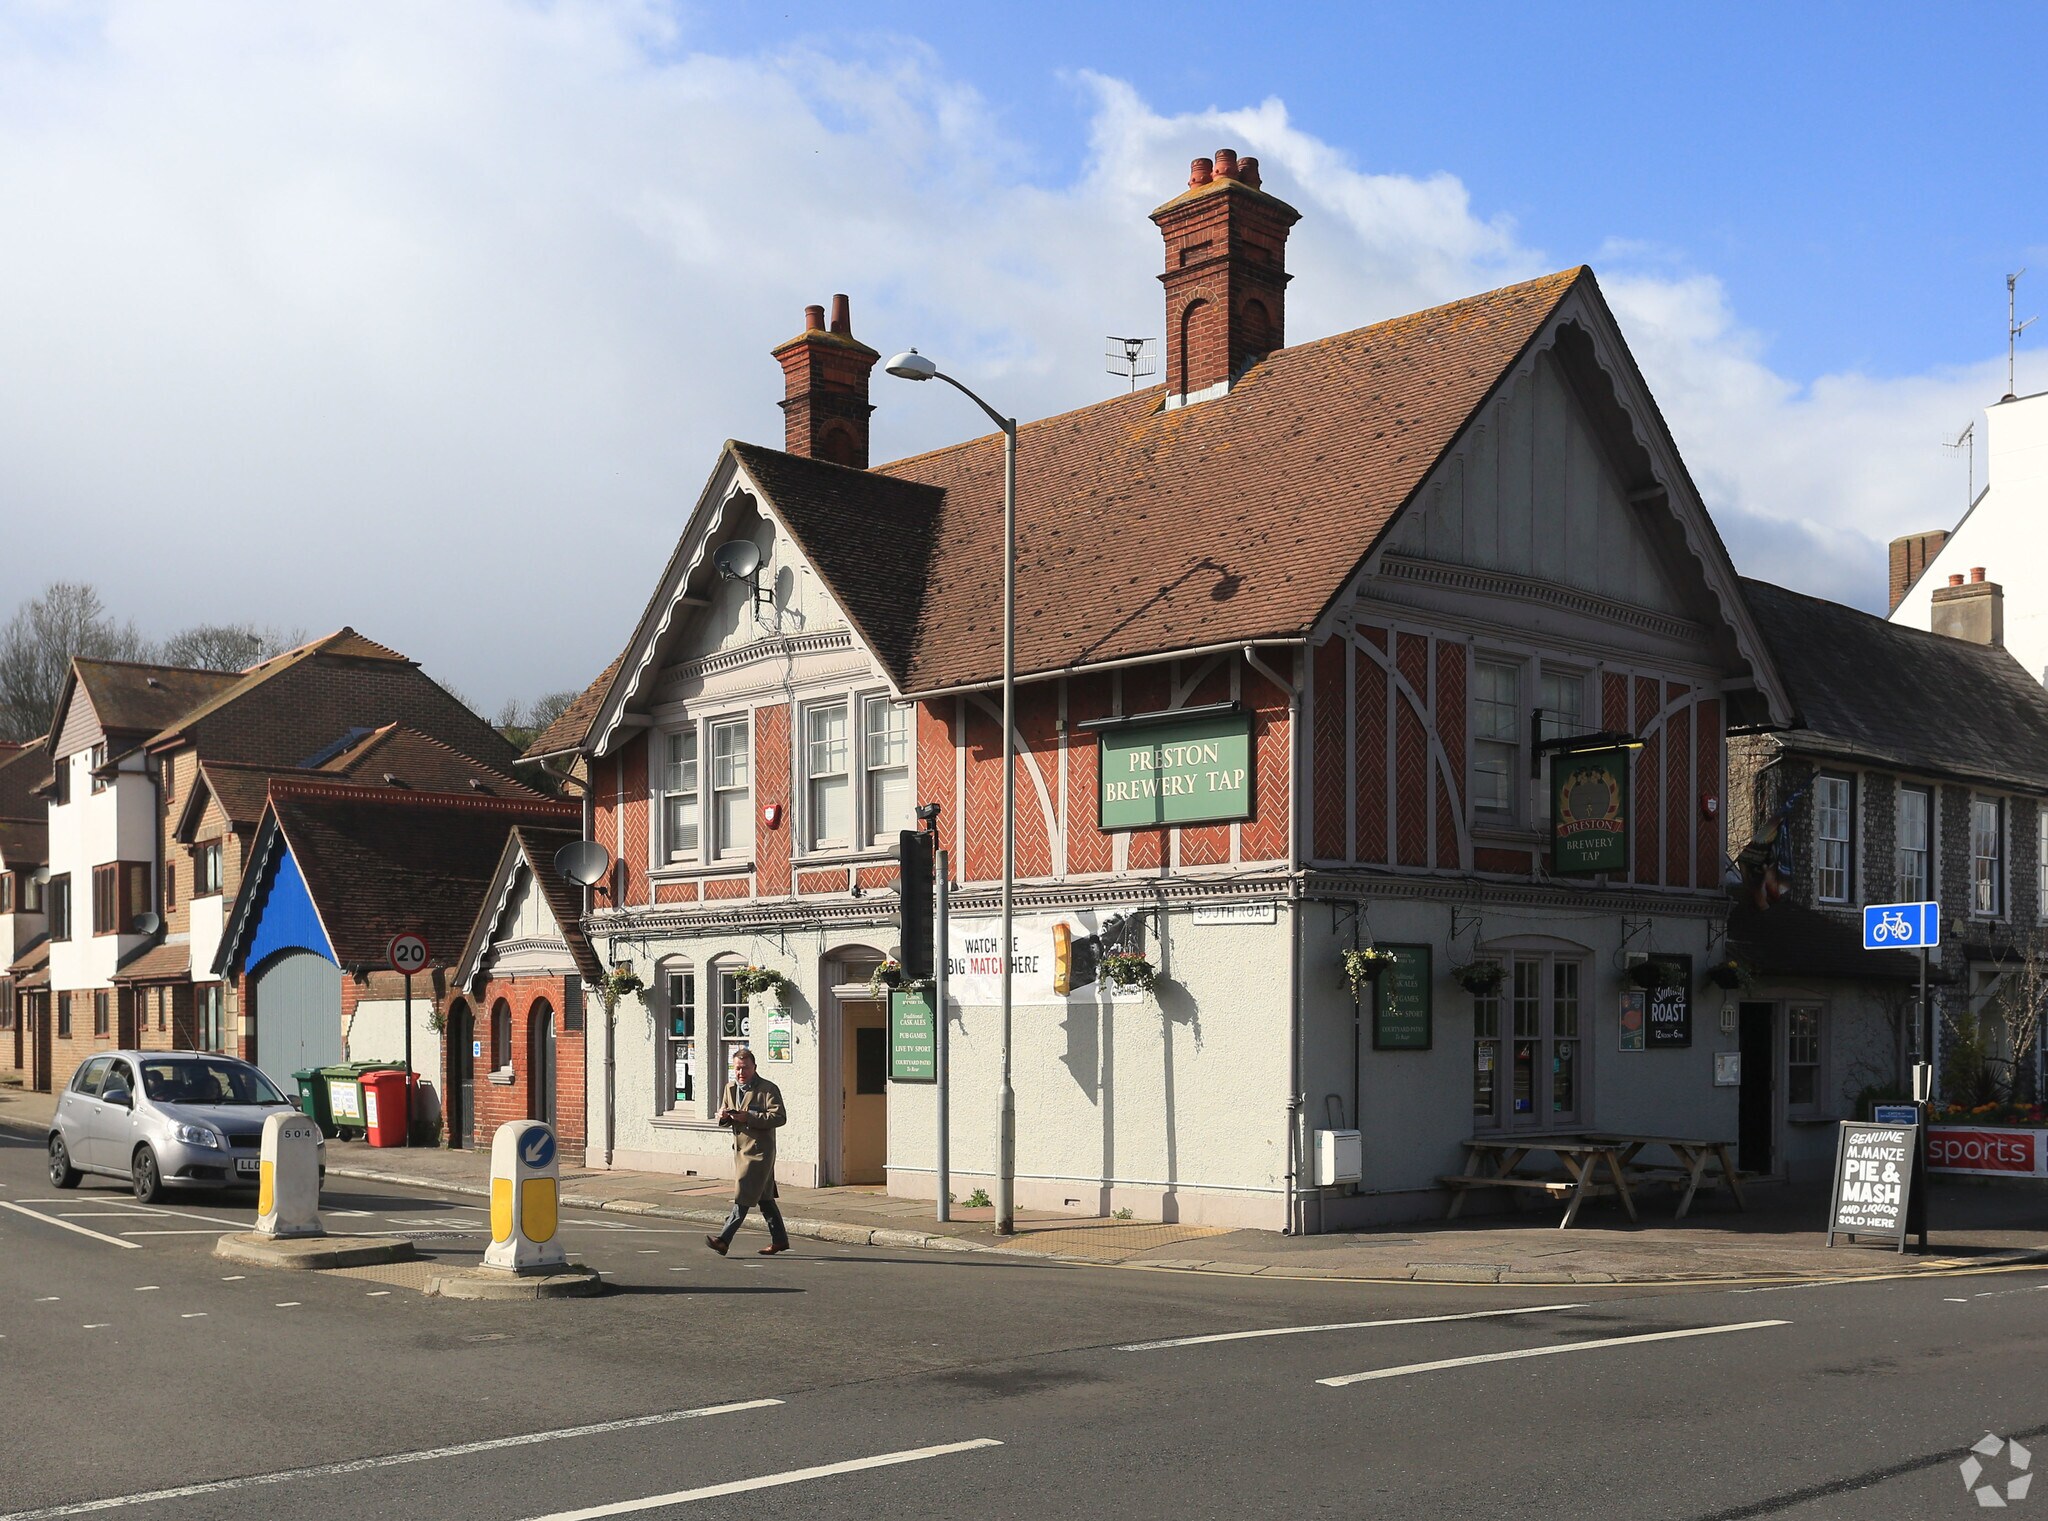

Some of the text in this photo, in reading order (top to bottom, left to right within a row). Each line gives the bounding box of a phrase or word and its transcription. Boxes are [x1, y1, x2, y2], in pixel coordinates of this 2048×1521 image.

[1129, 742, 1219, 772] PRESTON
[1106, 768, 1245, 802] BREWERY TAP
[1567, 819, 1614, 833] PRESTON
[1566, 837, 1614, 850] BREWERY
[1581, 851, 1600, 861] TAP
[1197, 905, 1270, 919] SOUTH ROAD
[396, 944, 425, 962] 20
[965, 937, 997, 954] WATCH
[1011, 956, 1039, 974] HERE
[1405, 1010, 1424, 1018] SPORT
[1651, 1003, 1687, 1022] ROAST
[1849, 1131, 1905, 1145] GENUINE
[1846, 1145, 1905, 1161] M.MANZE
[1928, 1138, 2027, 1165] sports
[1844, 1160, 1901, 1183] PIE &
[1842, 1181, 1901, 1205] MASH
[1839, 1204, 1899, 1217] AND LIQUOR
[1838, 1215, 1895, 1228] SOLD HERE
